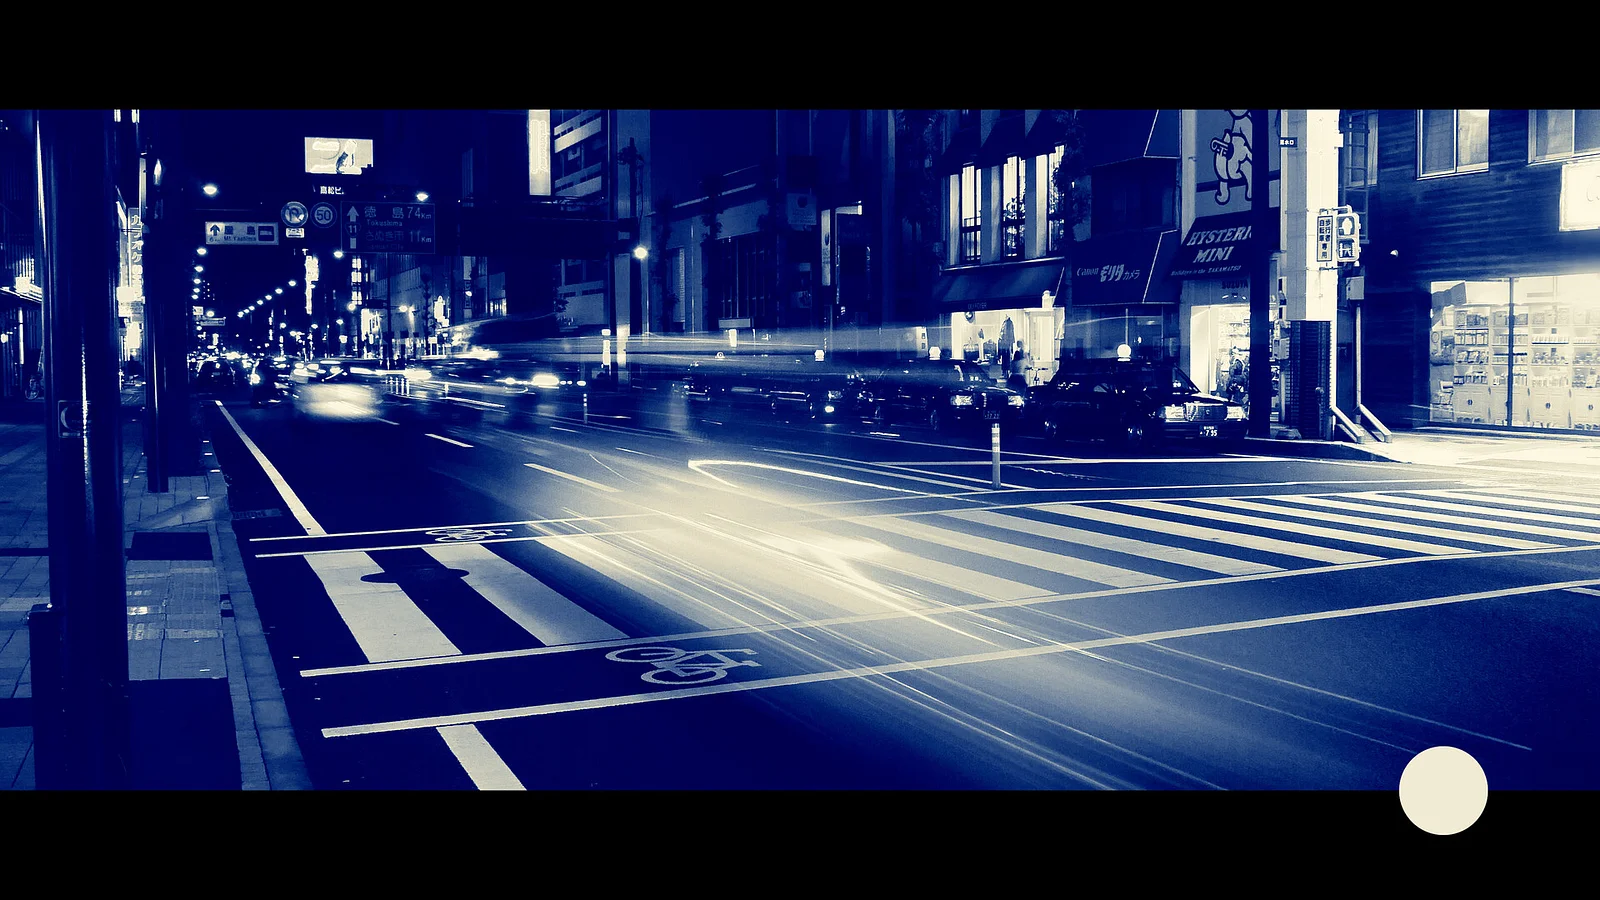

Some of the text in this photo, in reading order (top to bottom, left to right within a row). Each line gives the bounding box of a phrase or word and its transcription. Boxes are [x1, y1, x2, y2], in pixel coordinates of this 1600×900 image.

[316, 209, 331, 221] 50
[364, 206, 404, 219] 徳島
[366, 218, 403, 227] Tokushima
[348, 224, 357, 234] 11
[365, 230, 405, 242] さぬき市
[1192, 245, 1235, 264] MINI
[1076, 267, 1099, 277] Canon
[1207, 264, 1242, 274] TAKAMATSU
